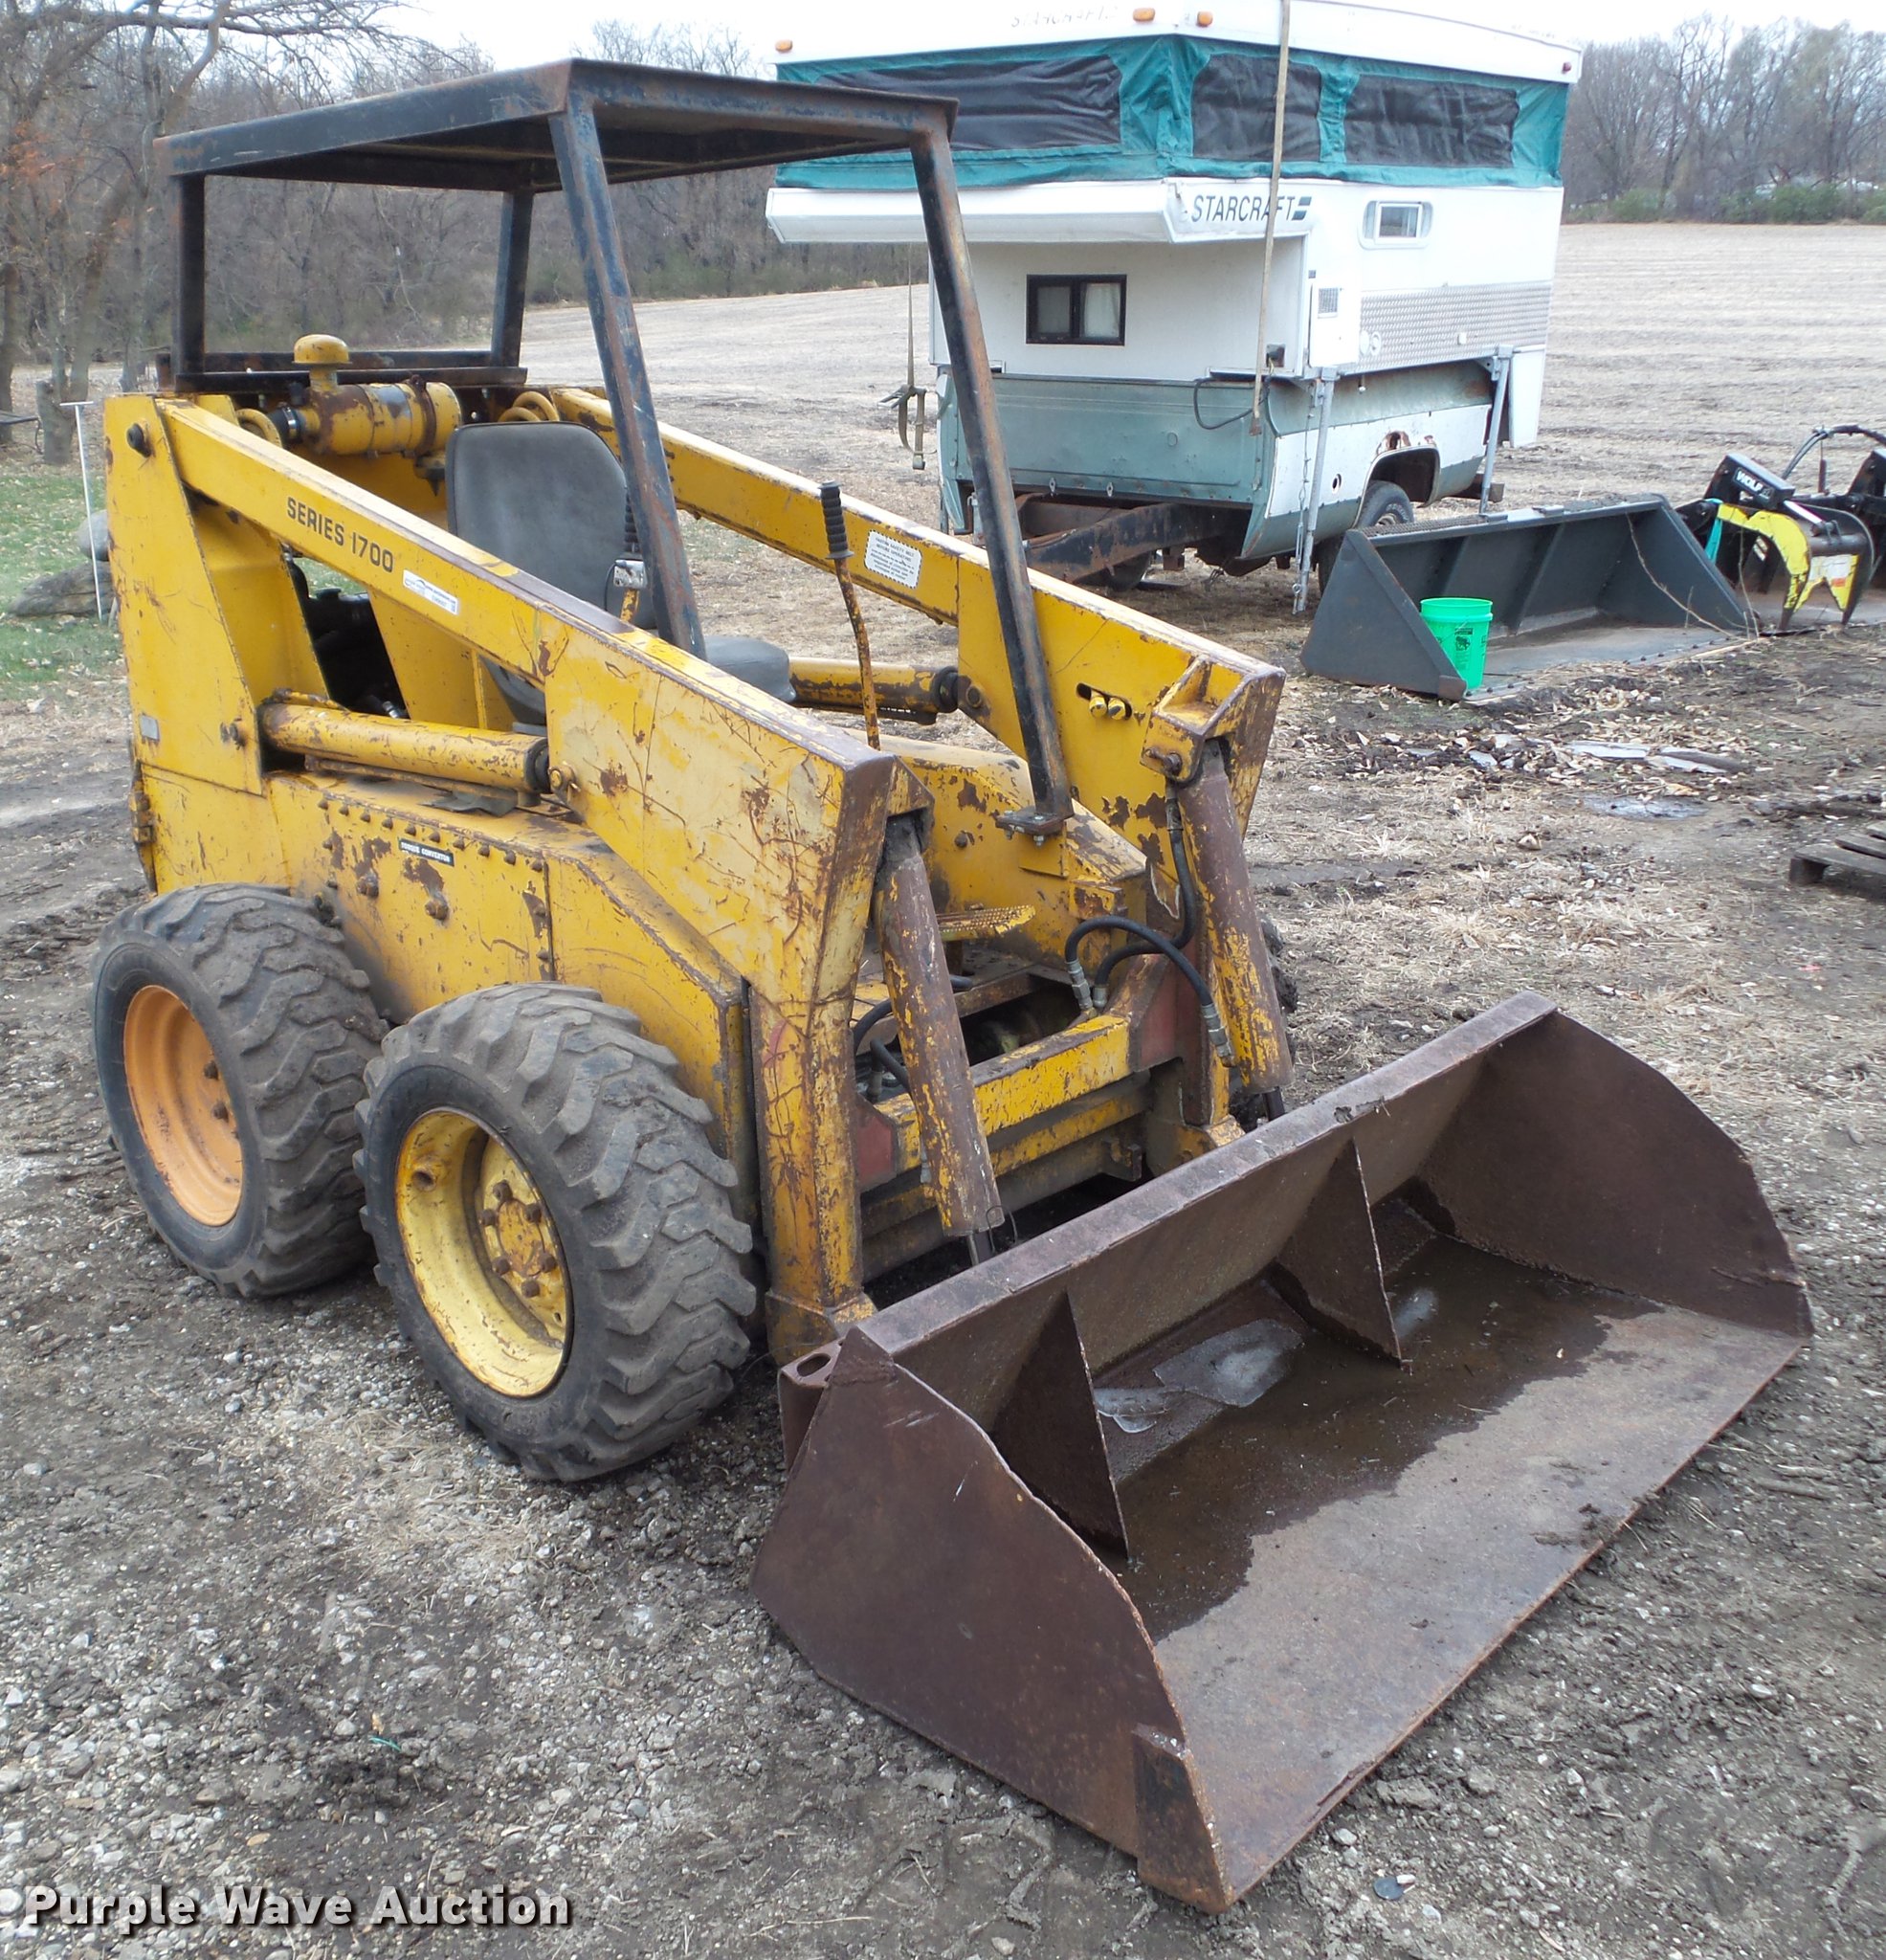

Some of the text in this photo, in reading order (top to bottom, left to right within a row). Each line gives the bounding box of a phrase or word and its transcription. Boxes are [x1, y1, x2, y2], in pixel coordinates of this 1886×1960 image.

[1191, 194, 1296, 222] STARCRAFT
[1737, 471, 1764, 492] WOLF
[287, 497, 394, 573] SERIES 1700
